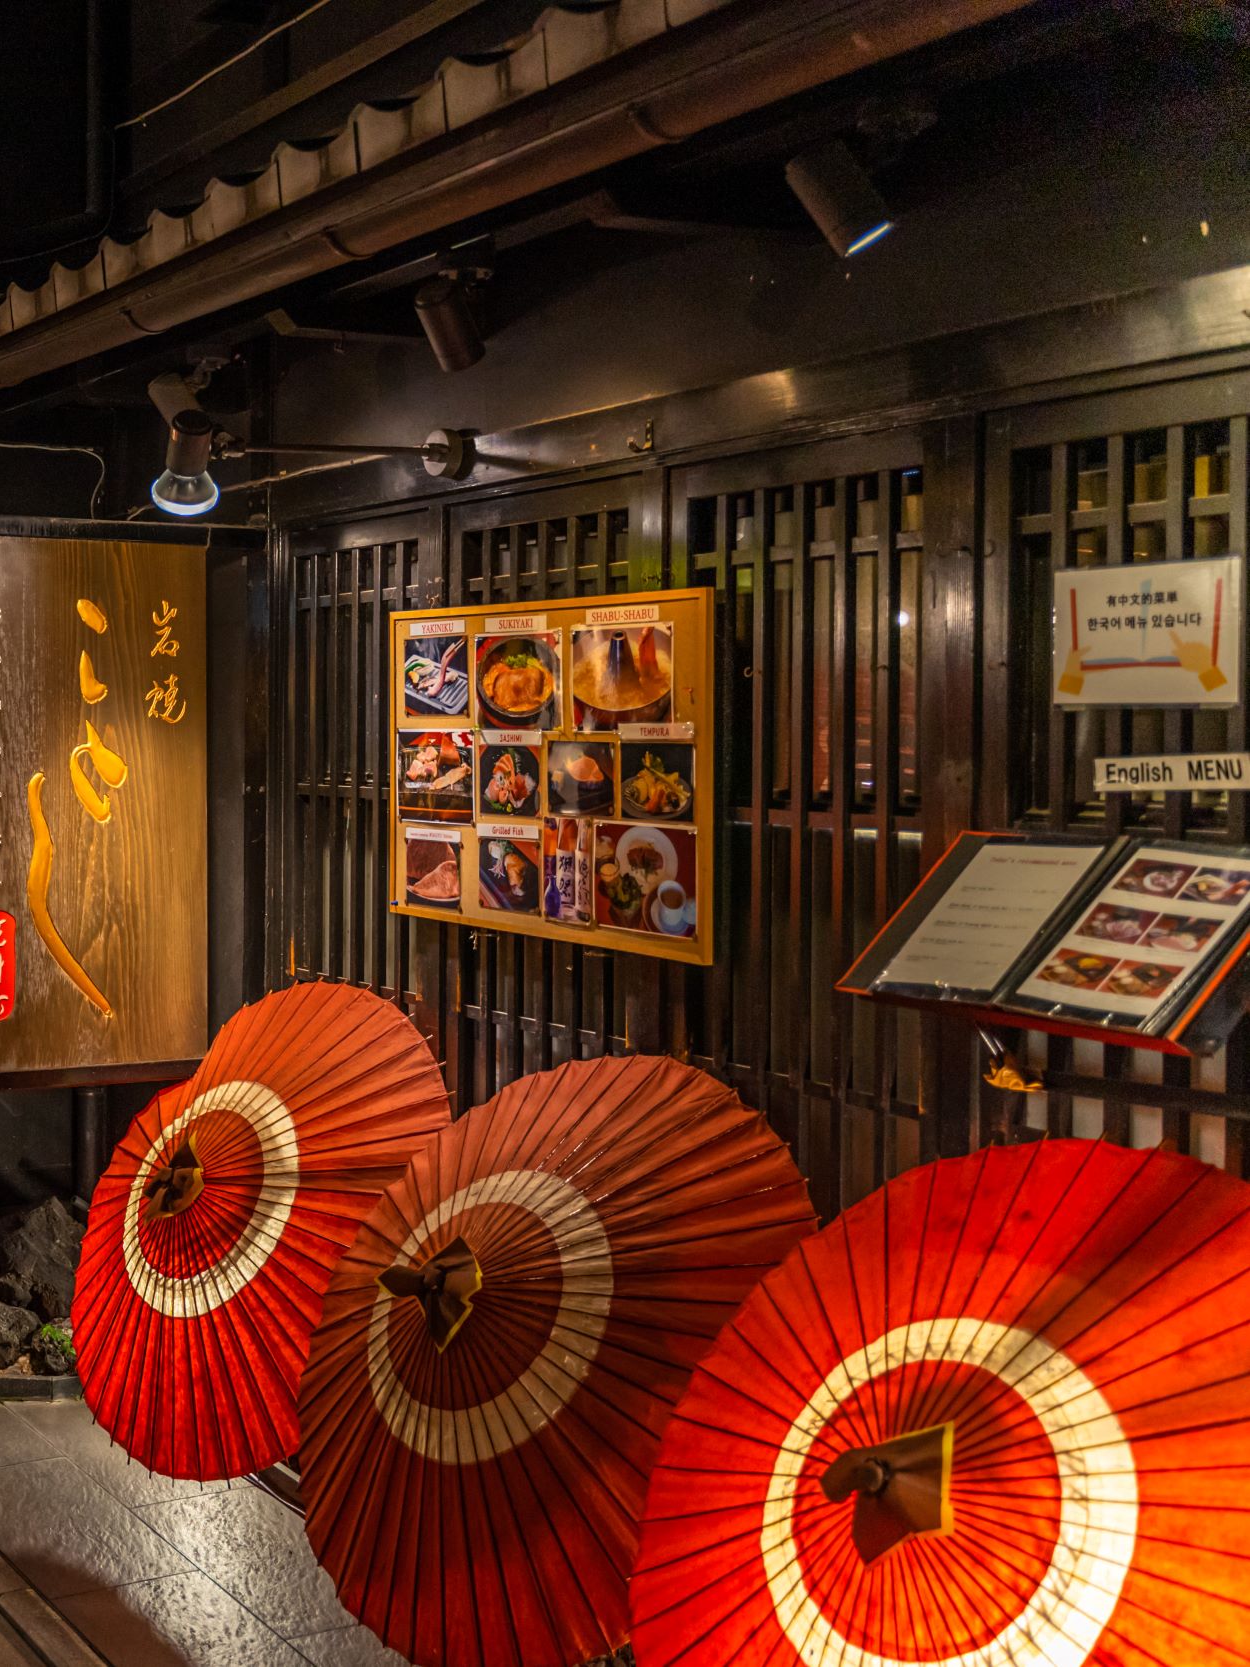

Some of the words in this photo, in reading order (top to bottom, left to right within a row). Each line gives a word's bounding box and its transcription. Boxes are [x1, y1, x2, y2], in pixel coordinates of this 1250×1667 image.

[591, 608, 654, 622] SHABU-SHABU
[498, 618, 533, 630] SUKIYAKI
[1087, 617, 1121, 631] 한국어
[1125, 615, 1147, 629] 메뉴
[1152, 612, 1202, 628] 있습니다
[421, 622, 454, 634] YAKINIKU
[640, 727, 670, 737] TEMPURA
[499, 734, 522, 743] SASHIMI
[1106, 762, 1173, 784] English
[1188, 759, 1243, 781] MENU
[28, 598, 128, 1018] ことし
[492, 825, 511, 836] Grilled
[513, 826, 524, 836] Fish
